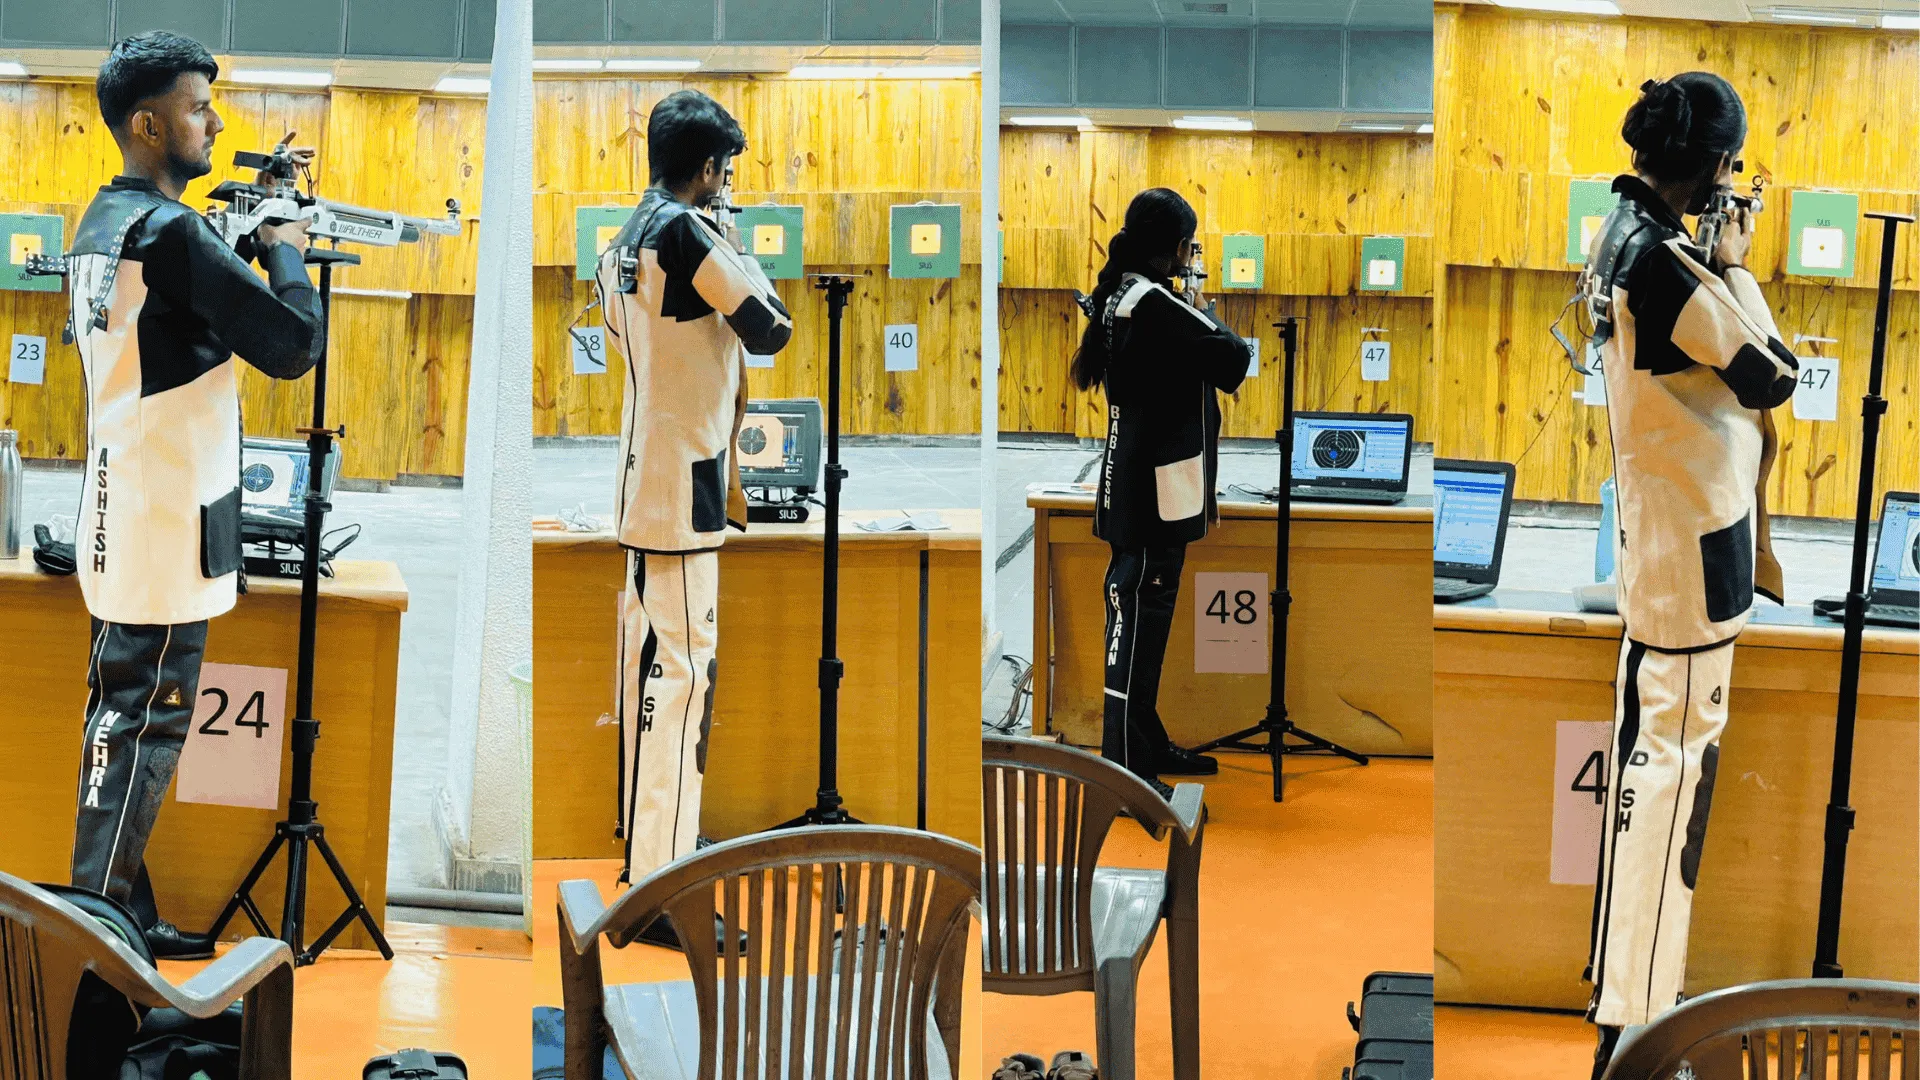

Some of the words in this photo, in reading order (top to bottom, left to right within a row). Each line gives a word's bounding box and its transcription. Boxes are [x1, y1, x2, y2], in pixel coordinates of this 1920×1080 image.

[338, 223, 383, 239] WALTHER
[16, 342, 40, 361] 23
[889, 332, 913, 349] 40
[1365, 348, 1386, 362] 47
[1800, 368, 1831, 390] 47
[1104, 405, 1120, 510] BABLESH
[93, 447, 108, 573] ASHISH
[779, 509, 798, 519] SIUS
[280, 562, 301, 574] SIUS
[1205, 589, 1258, 625] 48
[1108, 583, 1124, 667] CHARAN
[198, 687, 270, 738] 24
[85, 709, 122, 808] NEHRA
